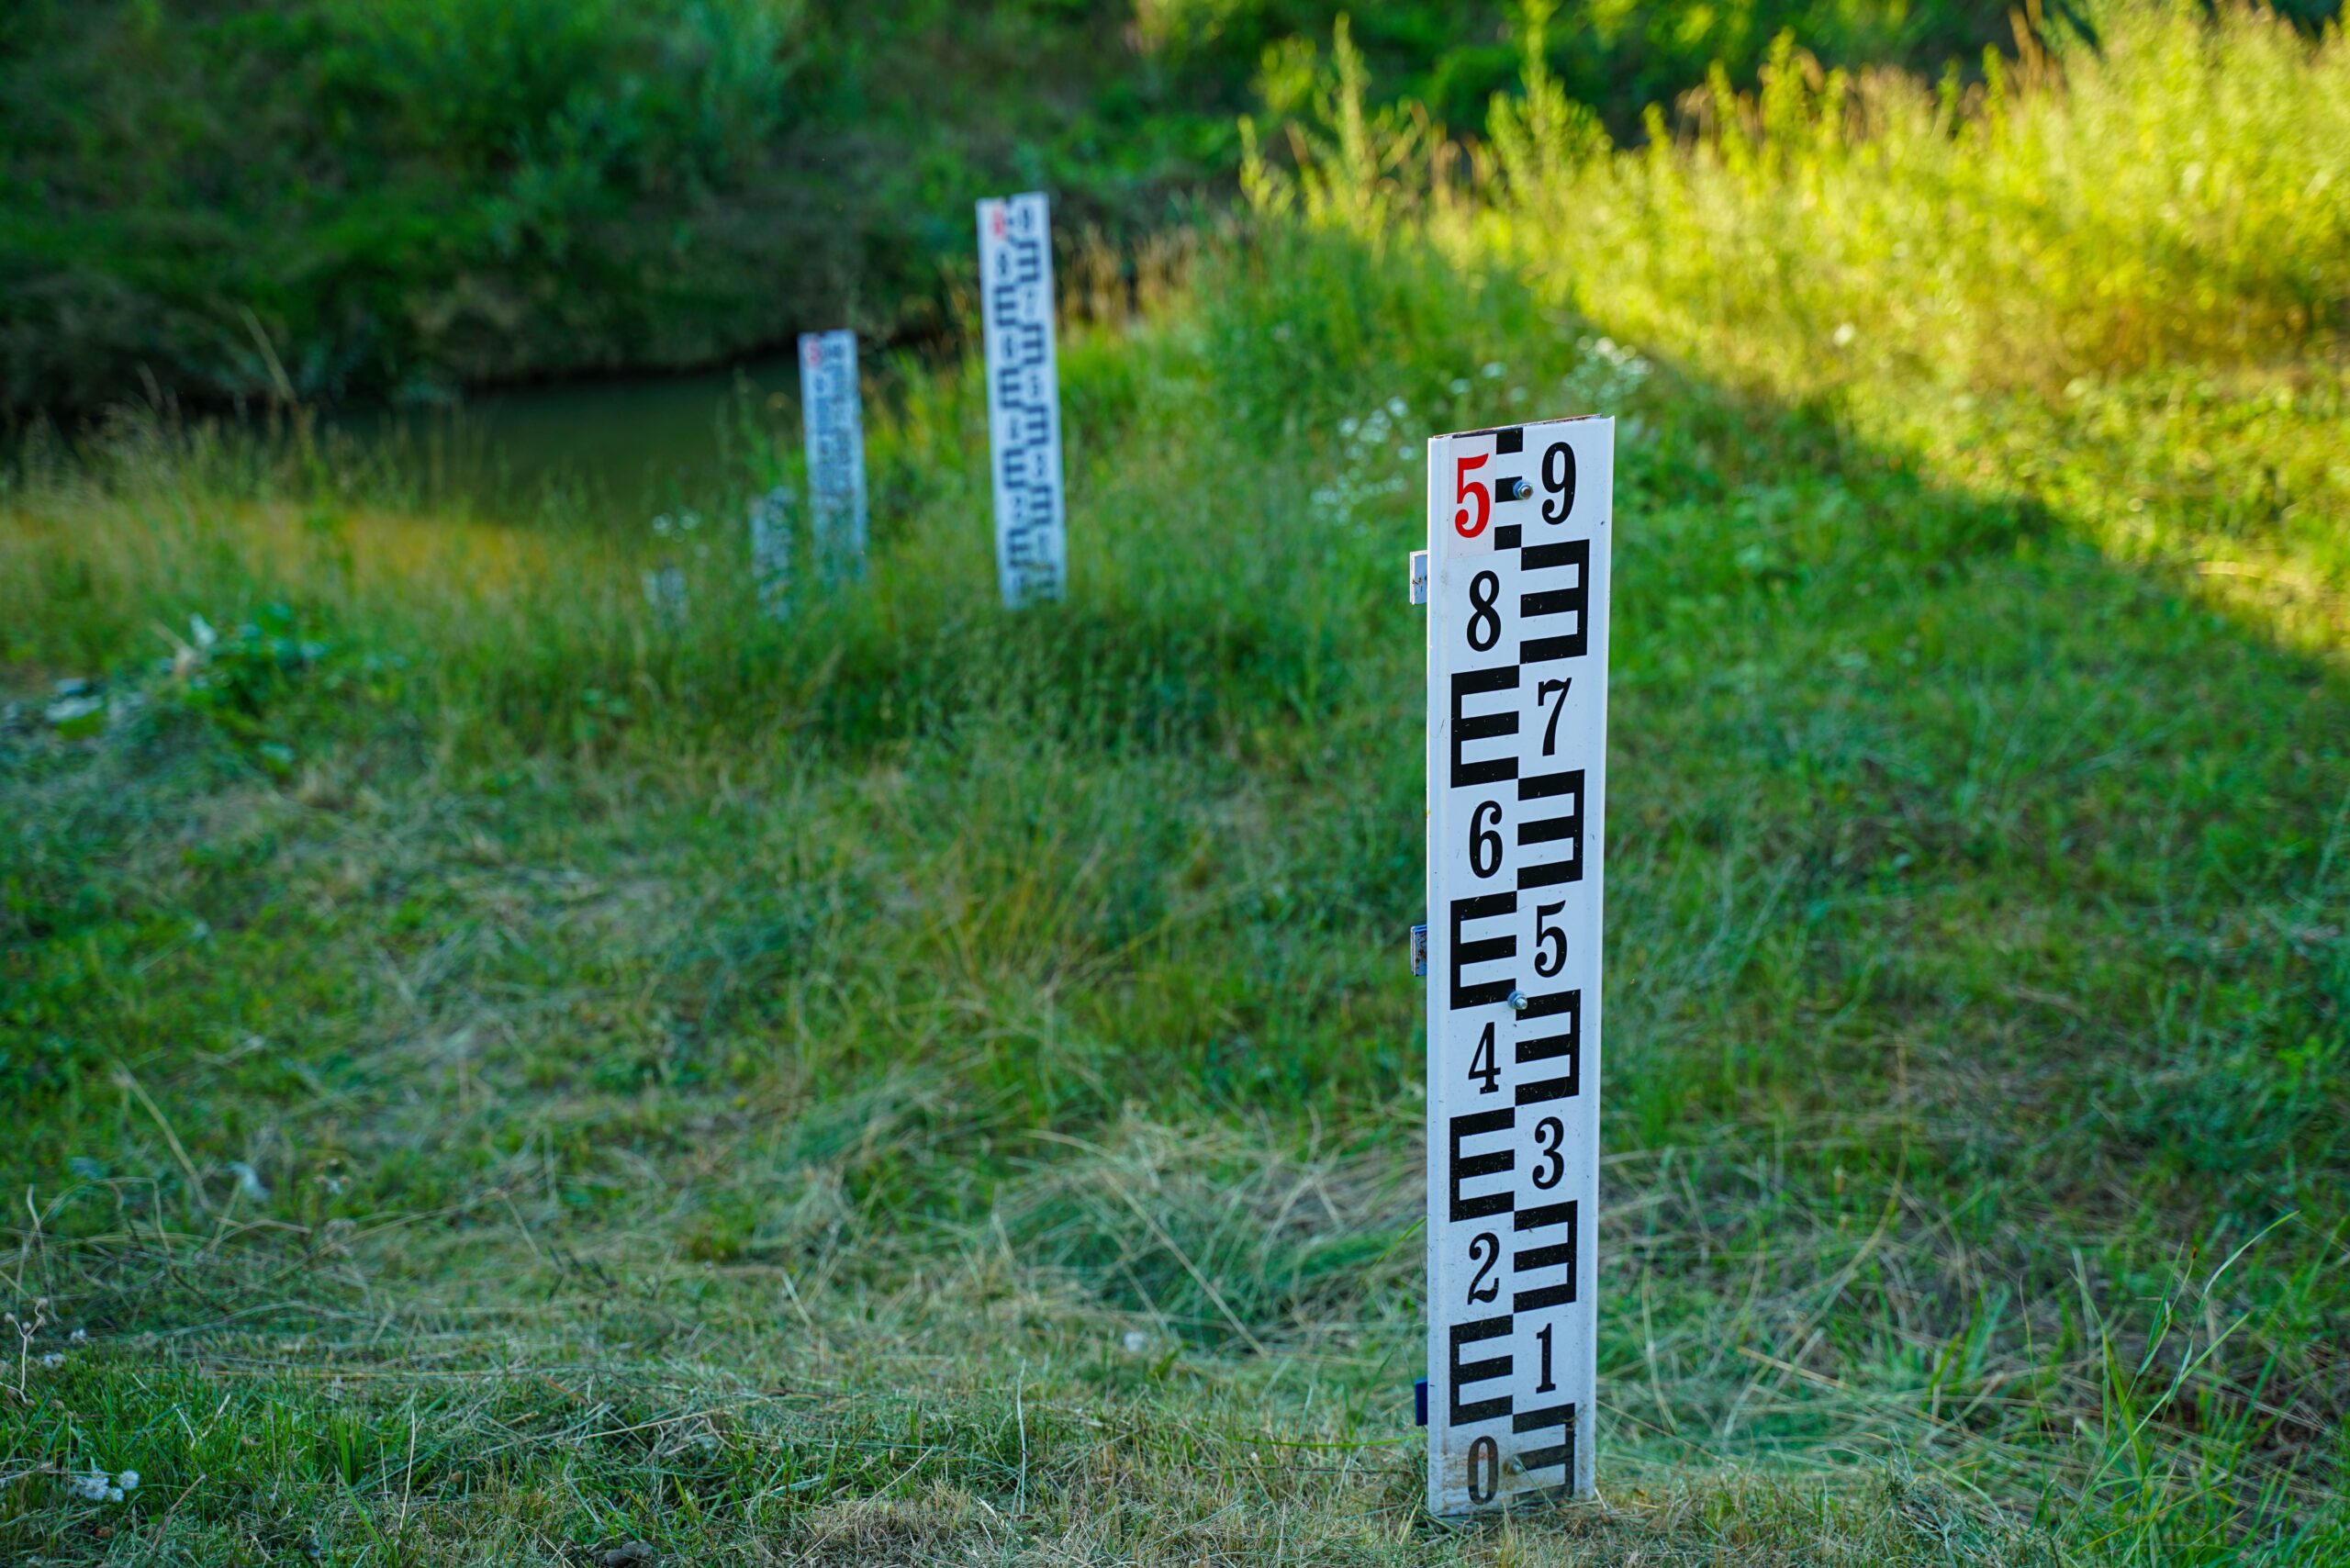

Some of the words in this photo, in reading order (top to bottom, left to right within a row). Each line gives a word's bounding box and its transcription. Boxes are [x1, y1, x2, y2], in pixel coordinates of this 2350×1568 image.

[1454, 453, 1491, 539] 5
[1541, 441, 1577, 525] 9
[1466, 569, 1502, 653] 8
[1538, 677, 1572, 757] 7
[1469, 800, 1504, 879] 6
[1534, 900, 1568, 979] 5
[1468, 1021, 1502, 1095] 4
[1532, 1115, 1565, 1191] 3
[1467, 1232, 1500, 1305] 2
[1535, 1322, 1557, 1394] 1
[1467, 1435, 1499, 1506] 0
